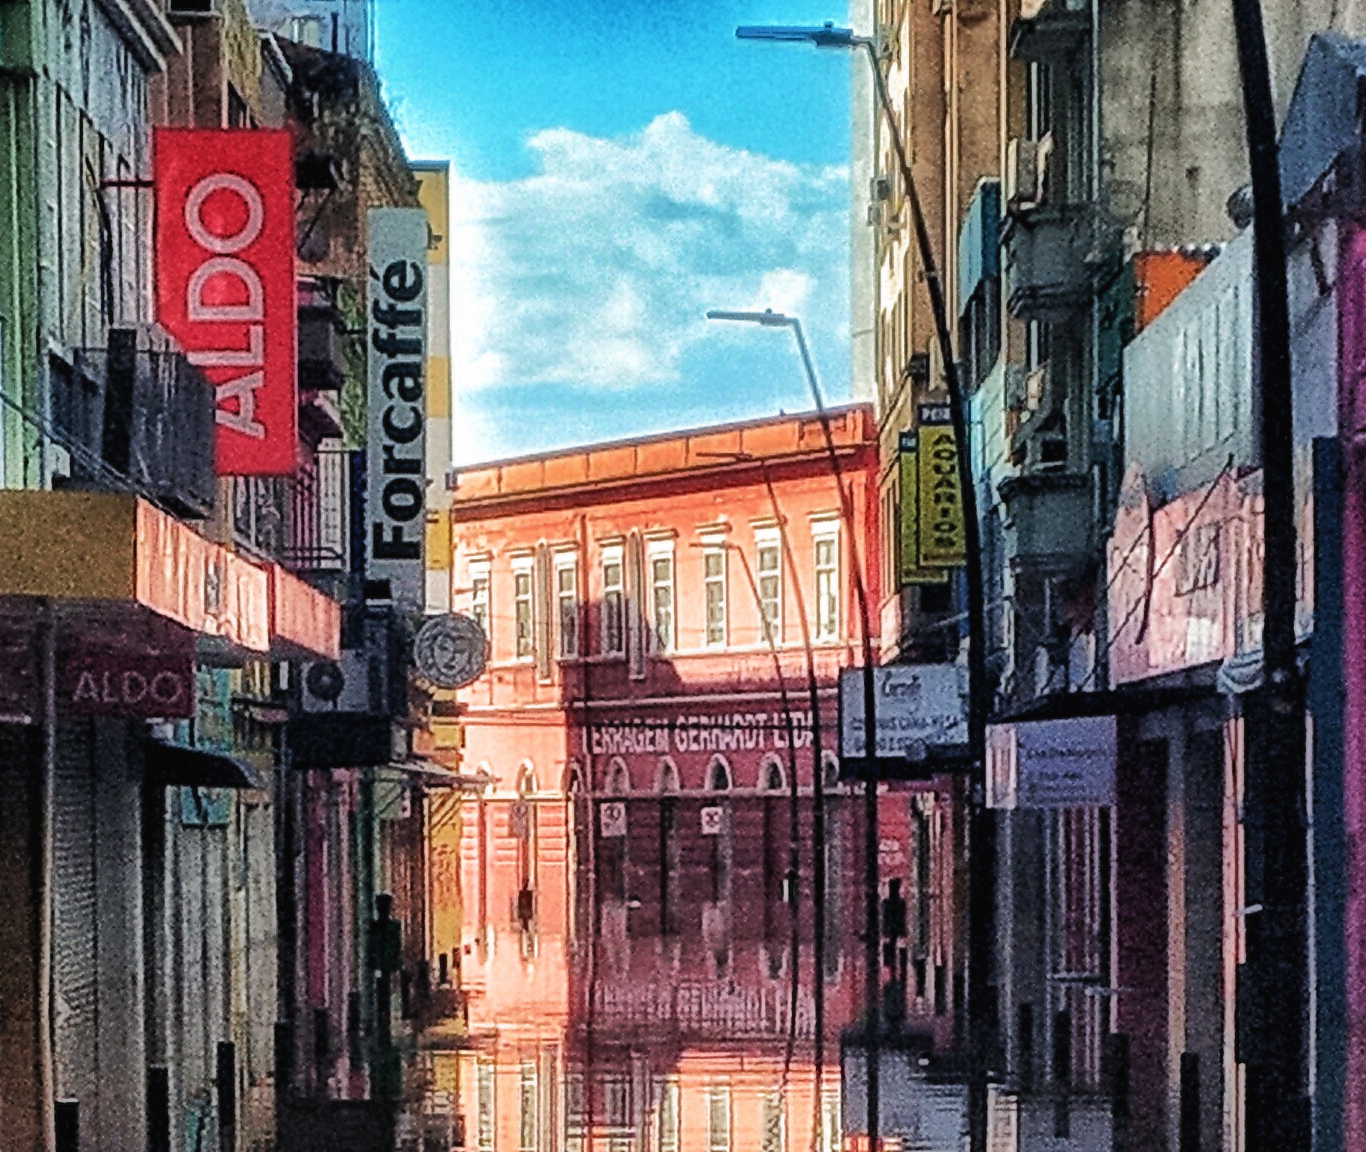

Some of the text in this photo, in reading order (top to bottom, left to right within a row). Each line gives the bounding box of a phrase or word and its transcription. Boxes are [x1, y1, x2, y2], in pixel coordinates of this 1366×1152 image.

[184, 171, 266, 440] ALDO
[370, 258, 423, 560] Forcaffé
[72, 670, 183, 703] ALDO
